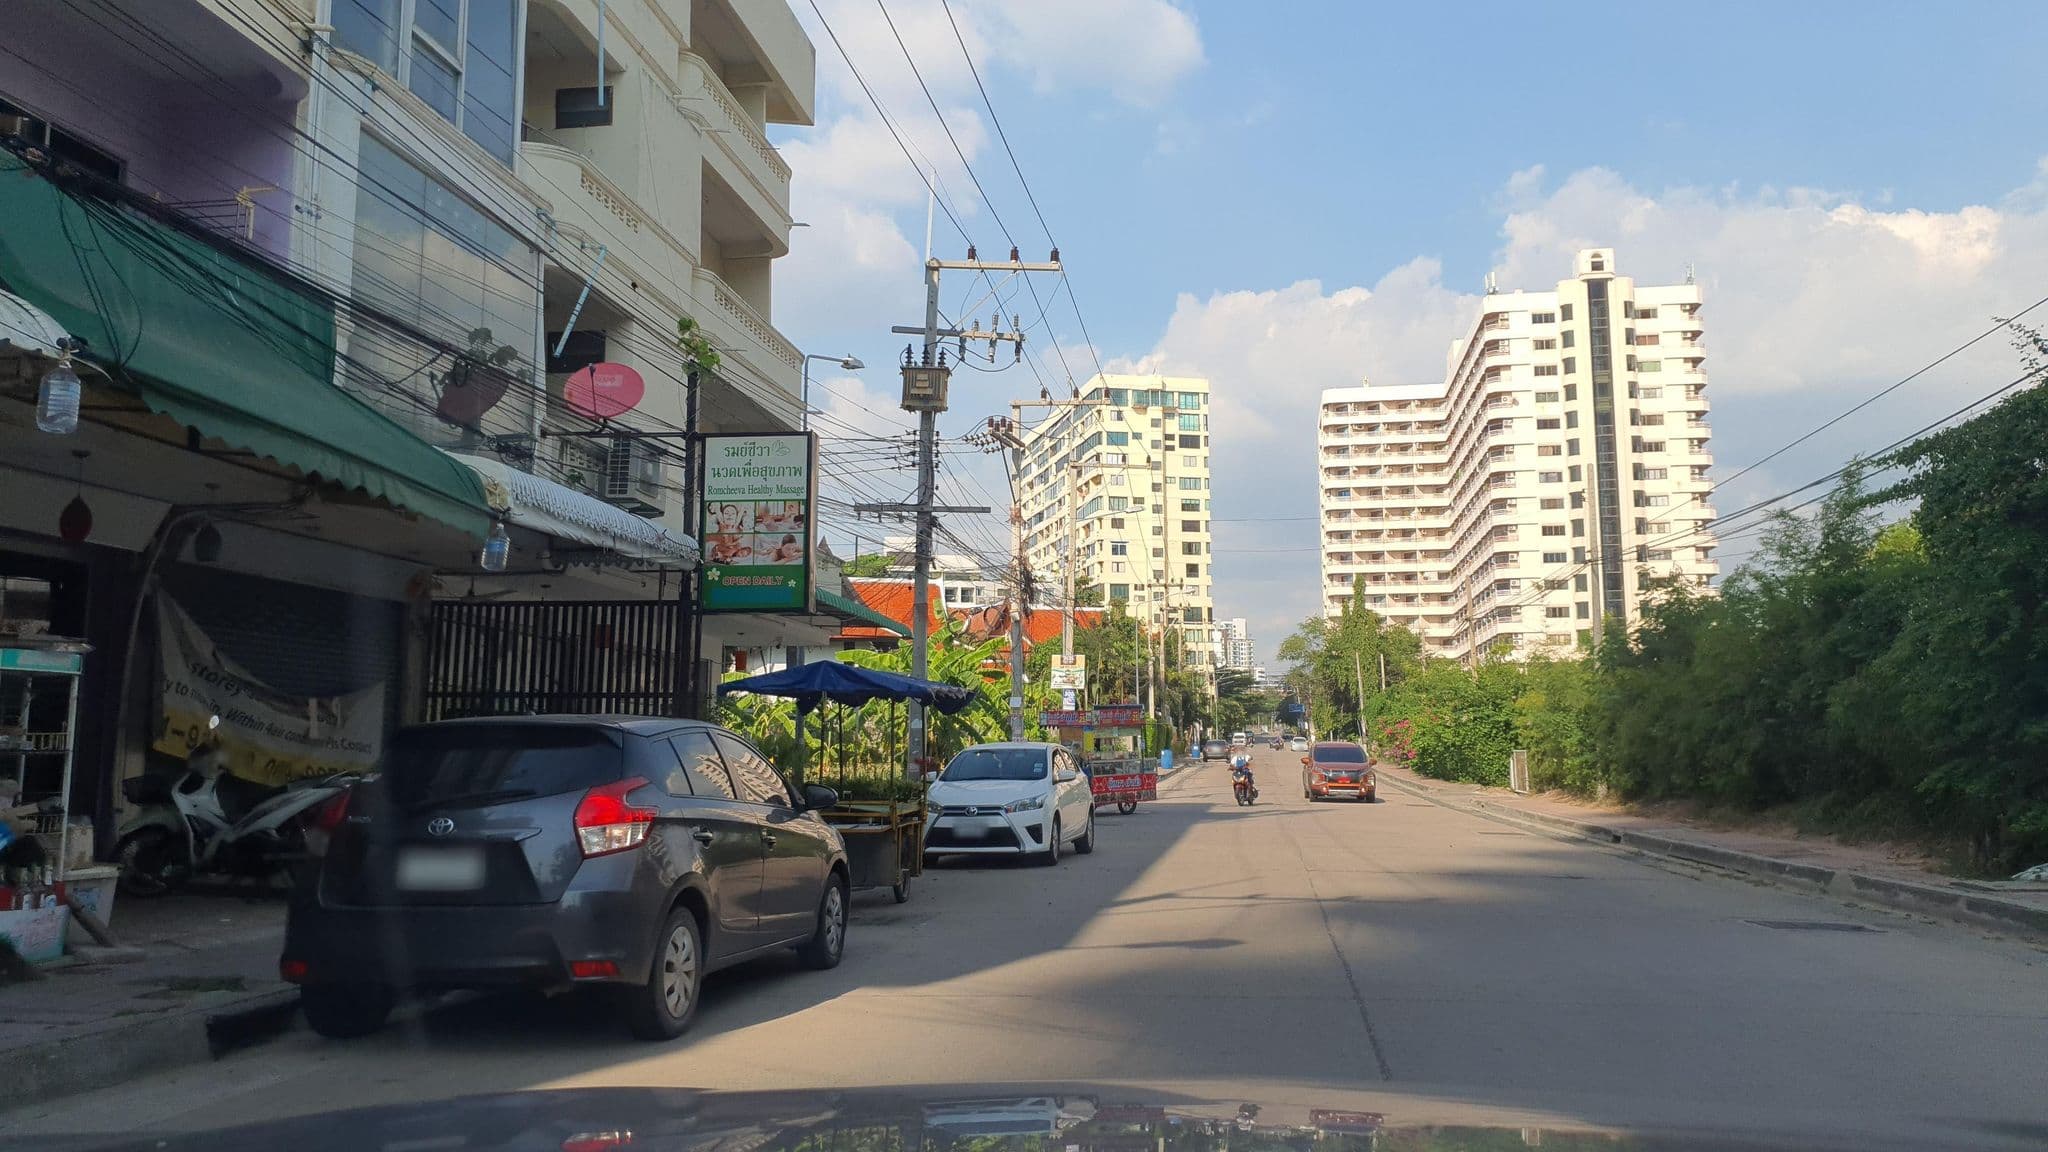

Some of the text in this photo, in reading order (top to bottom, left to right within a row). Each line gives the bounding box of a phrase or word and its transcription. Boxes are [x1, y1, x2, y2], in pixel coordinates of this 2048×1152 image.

[711, 459, 802, 481] นวดเพื่อสุขภาพ
[707, 484, 805, 496] Romcheeva Healthy Massage
[722, 576, 784, 586] OPEN DAILY
